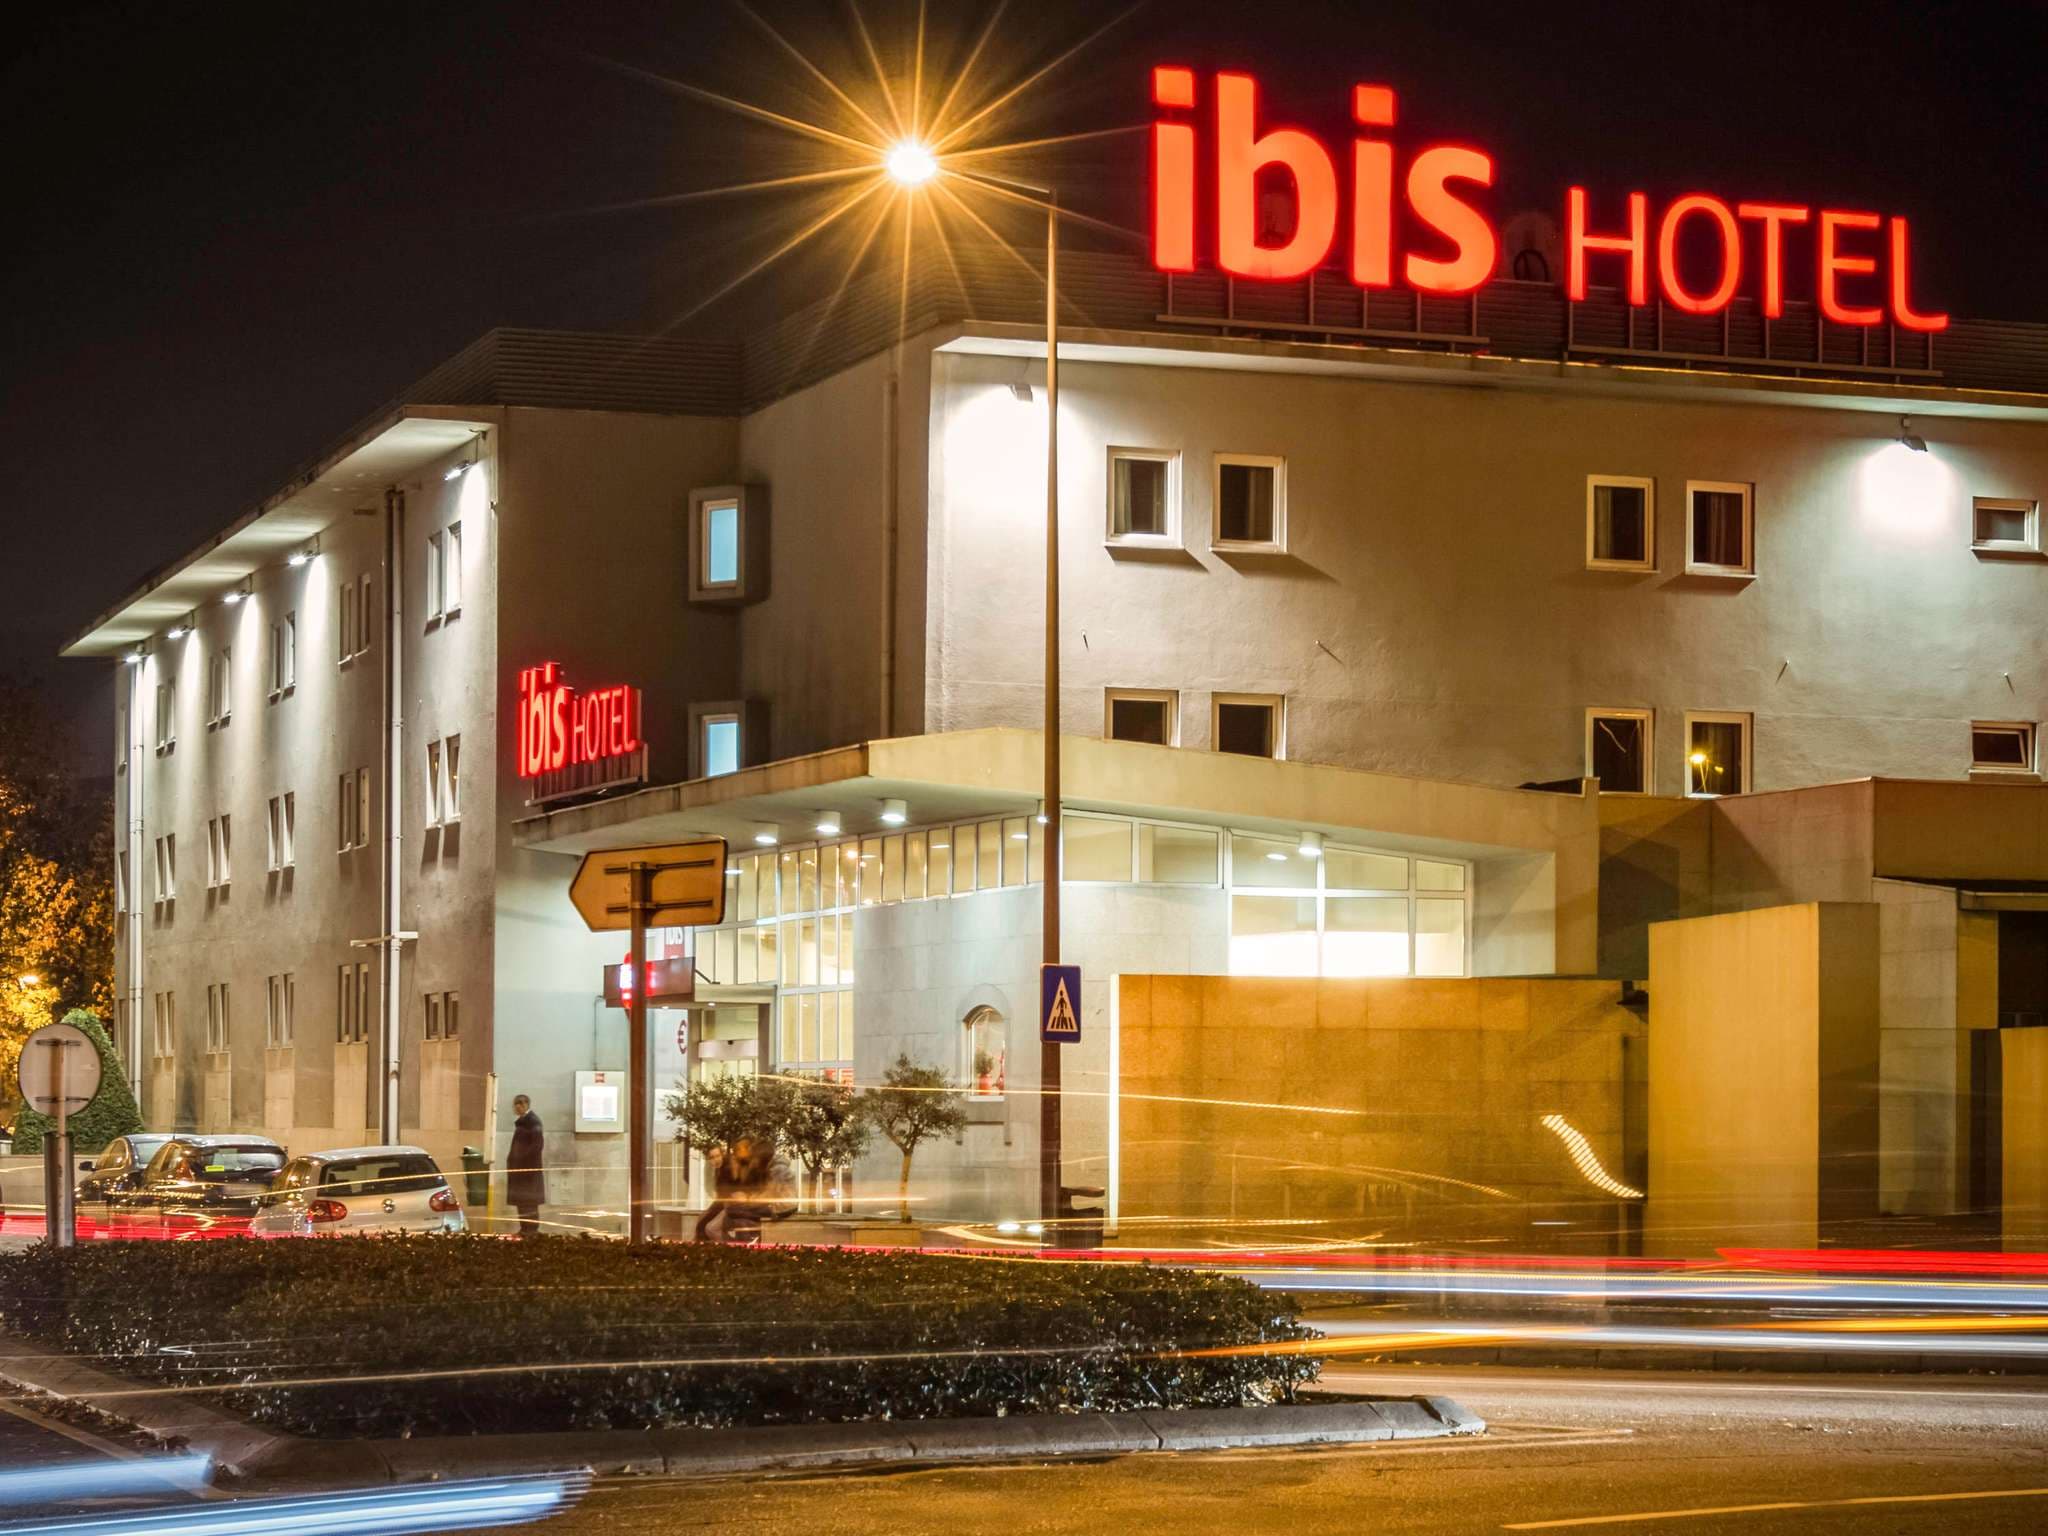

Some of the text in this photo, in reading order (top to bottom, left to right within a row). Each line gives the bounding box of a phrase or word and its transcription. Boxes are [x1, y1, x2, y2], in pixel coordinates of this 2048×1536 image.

[1152, 66, 1947, 330] ibis HOTEL
[519, 661, 638, 777] ibis HOTEL
